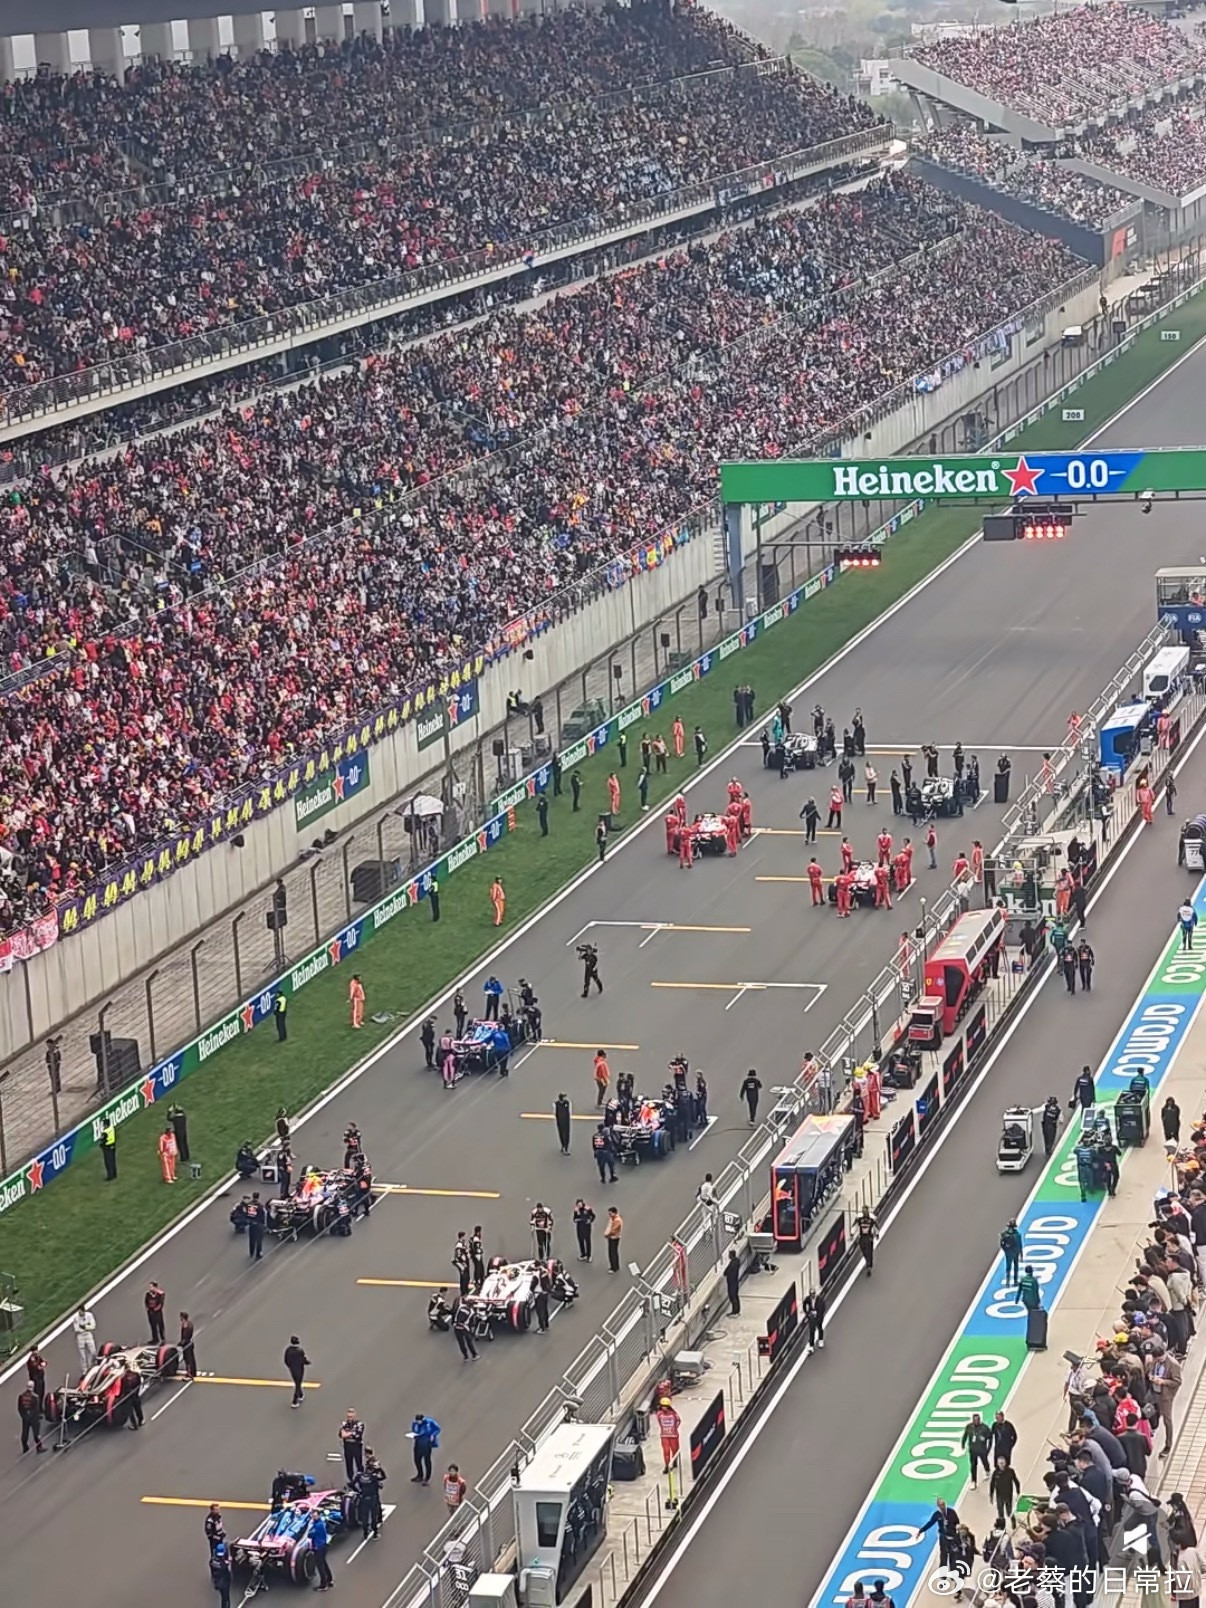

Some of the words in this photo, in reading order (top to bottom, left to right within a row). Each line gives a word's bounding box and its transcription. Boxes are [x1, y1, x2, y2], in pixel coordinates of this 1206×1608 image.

[833, 464, 998, 496] Heineken
[1067, 460, 1109, 489] 0.0
[297, 787, 332, 821] Heineken
[291, 953, 328, 992] Heineken
[198, 1019, 240, 1061] Heineken
[1112, 1004, 1186, 1077] aramco
